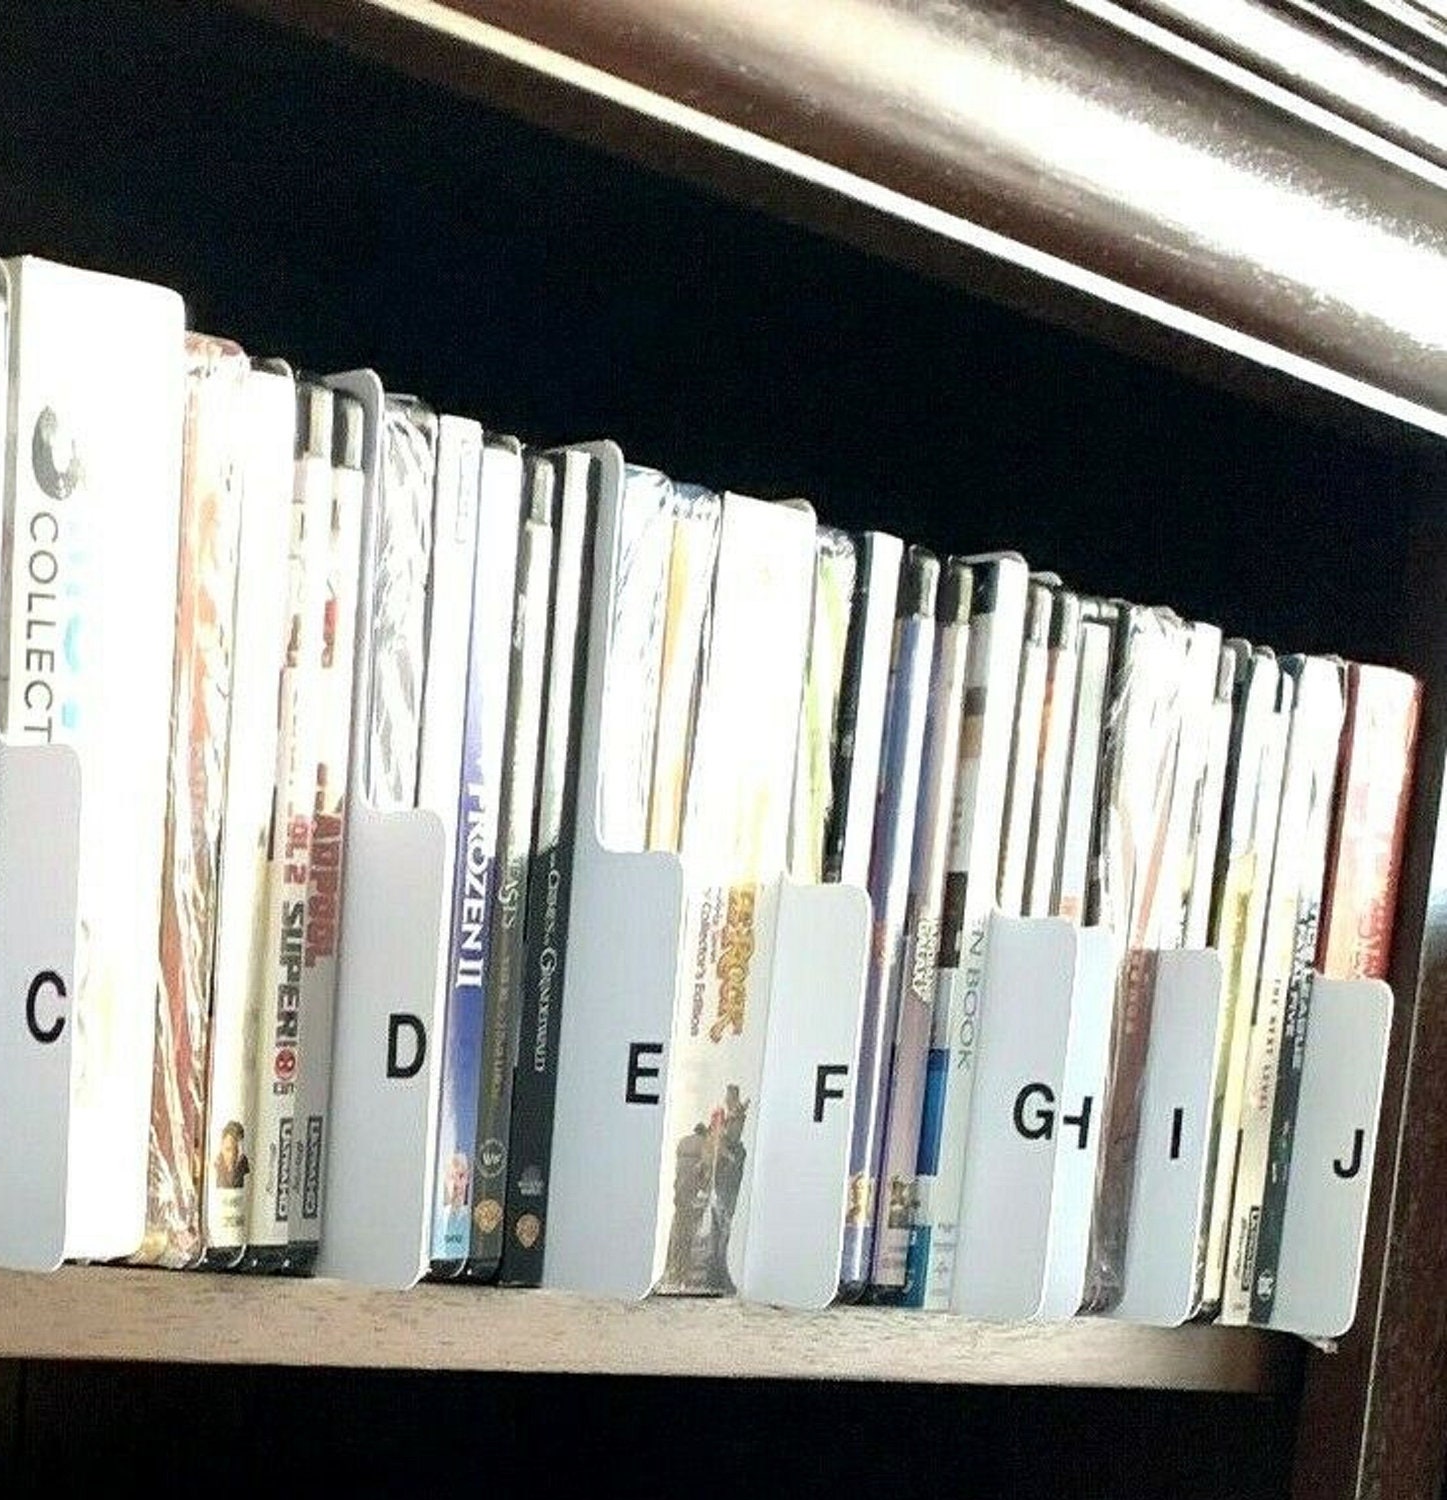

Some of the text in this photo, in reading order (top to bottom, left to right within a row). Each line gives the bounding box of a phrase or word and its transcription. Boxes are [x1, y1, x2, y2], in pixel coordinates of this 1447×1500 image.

[273, 899, 306, 1042] SUPER
[690, 902, 713, 1037] Collector's Edition
[25, 969, 68, 1045] C
[956, 967, 985, 1071] BOOK
[385, 1013, 428, 1080] D
[625, 1041, 664, 1105] E
[812, 1064, 849, 1123] F
[1012, 1081, 1054, 1142] G
[1332, 1128, 1365, 1179] J
